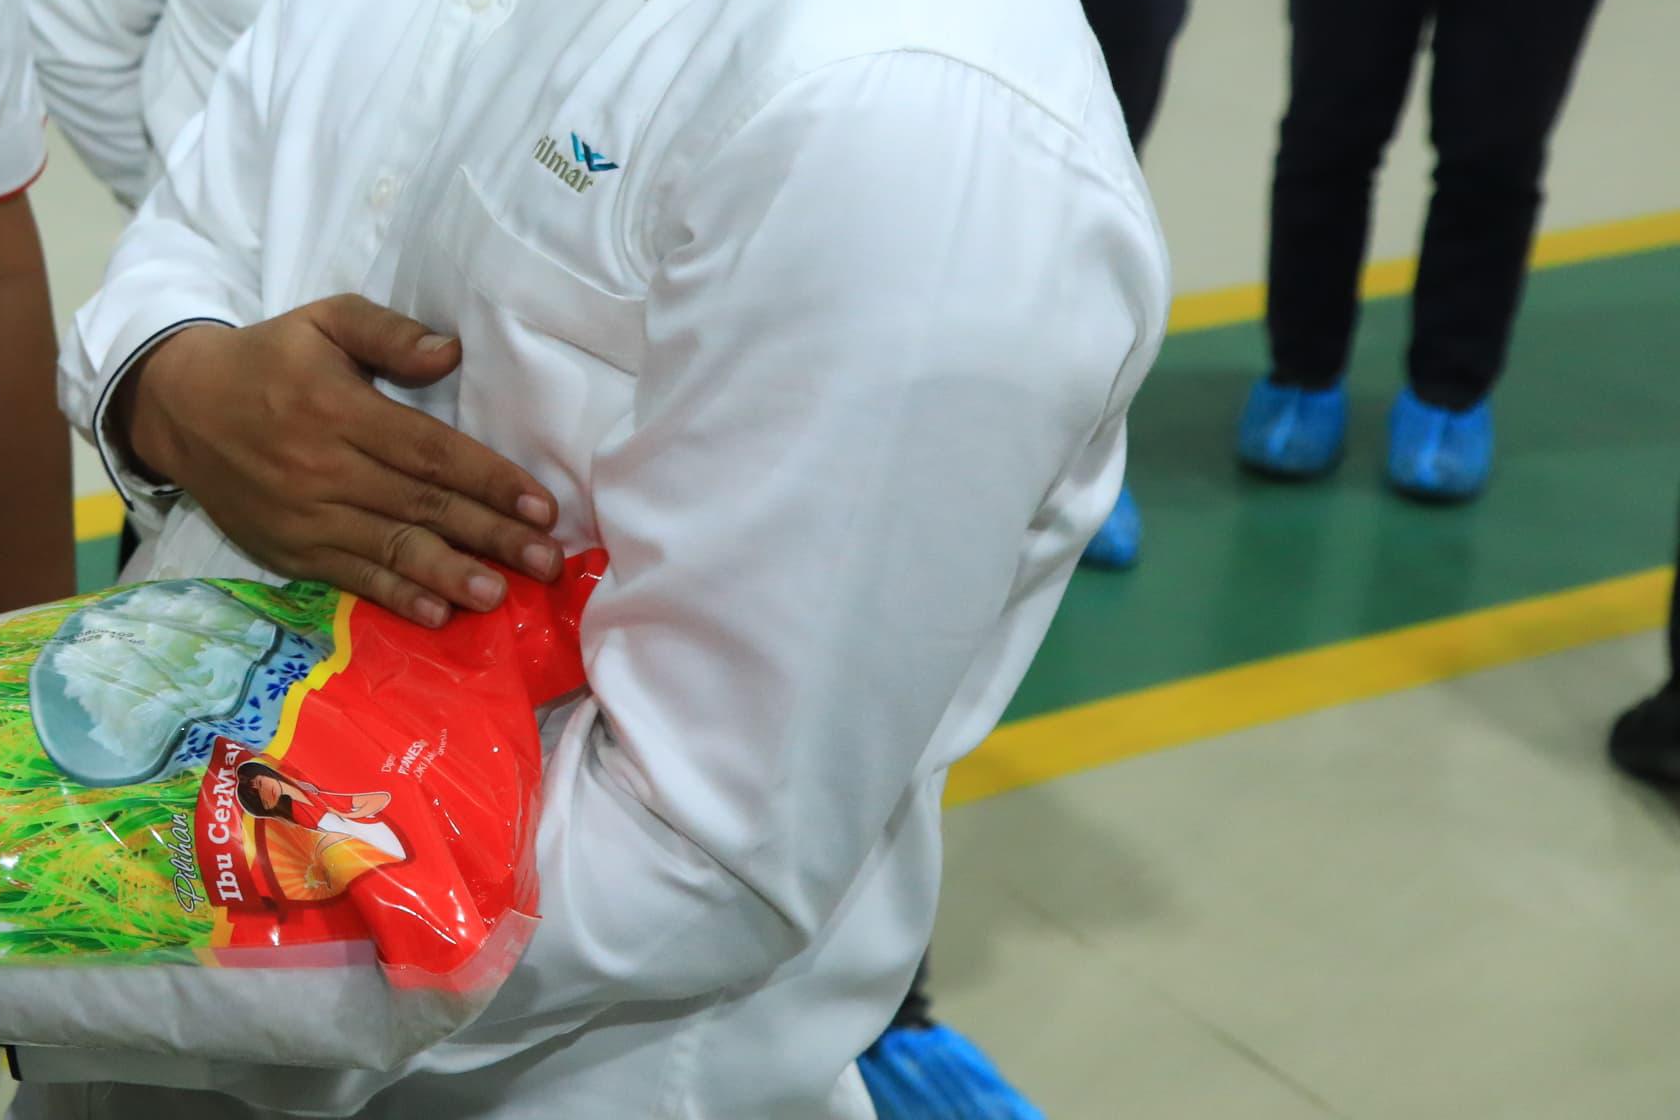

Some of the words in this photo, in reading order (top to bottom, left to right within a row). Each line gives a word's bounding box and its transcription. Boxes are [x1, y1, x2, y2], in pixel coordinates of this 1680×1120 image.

[532, 135, 594, 193] ilmar
[167, 812, 206, 914] Pilihan
[215, 852, 244, 902] Ibu
